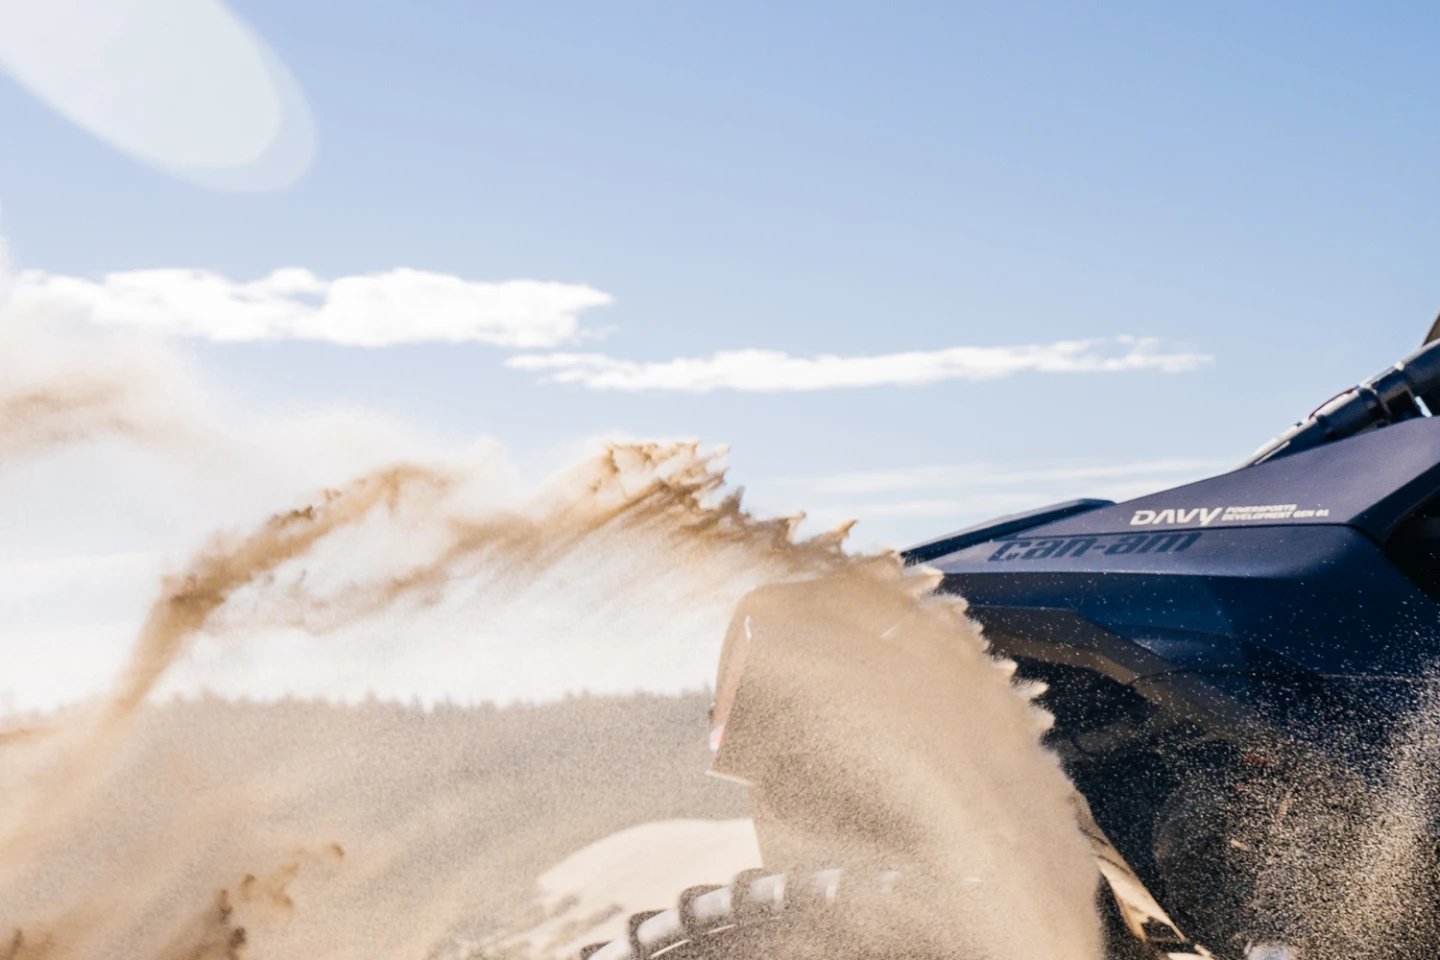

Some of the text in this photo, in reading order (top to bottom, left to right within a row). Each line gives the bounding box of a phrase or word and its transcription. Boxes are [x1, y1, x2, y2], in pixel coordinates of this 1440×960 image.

[1130, 508, 1223, 526] DAVY
[1221, 511, 1292, 521] DEVELOPMENT
[987, 532, 1201, 562] can-am
